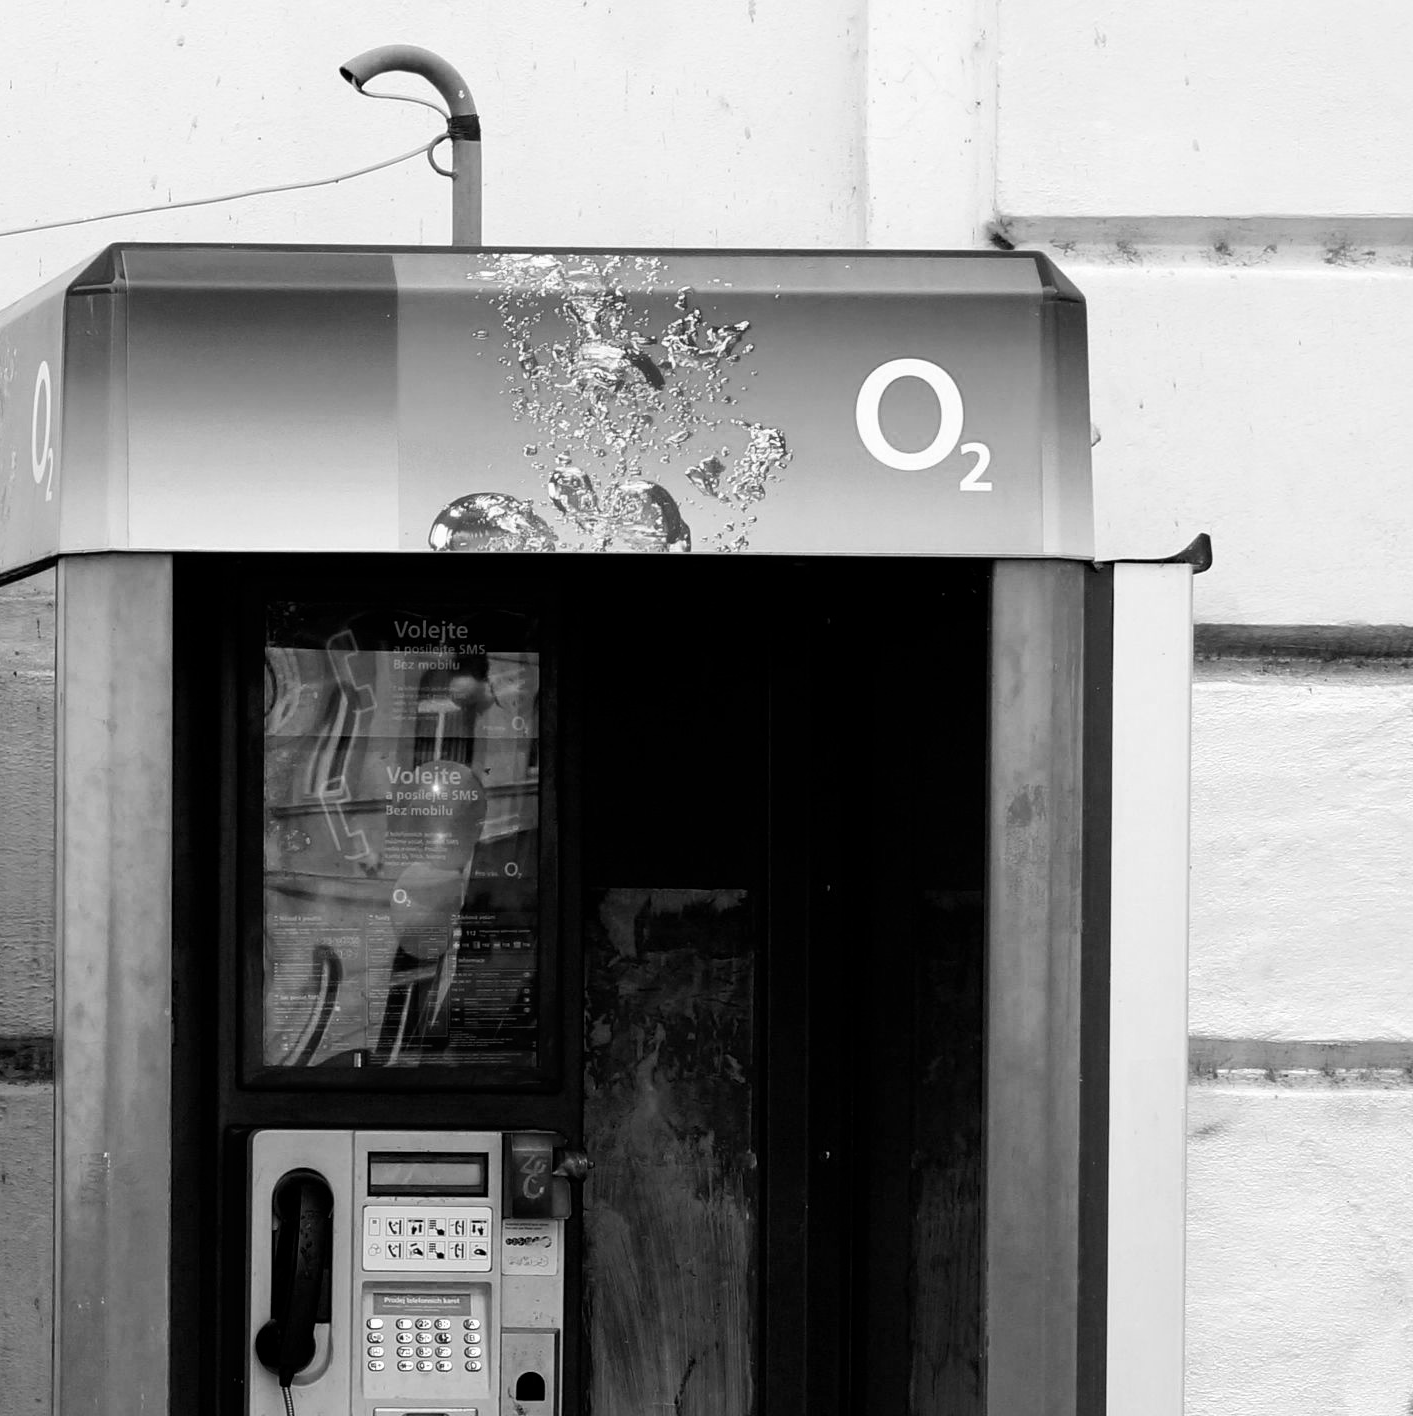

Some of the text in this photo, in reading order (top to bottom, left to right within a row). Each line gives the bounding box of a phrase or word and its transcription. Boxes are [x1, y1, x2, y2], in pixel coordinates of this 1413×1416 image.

[31, 360, 54, 502] O2
[855, 357, 993, 491] O2
[393, 619, 469, 643] Volejte
[404, 643, 456, 657] posílejte
[459, 643, 486, 655] SMS
[393, 659, 461, 671] Bez mobilu
[386, 765, 462, 789] Volejte
[451, 789, 479, 801] SMS
[385, 804, 454, 817] Bez mobilu
[392, 888, 412, 908] O2
